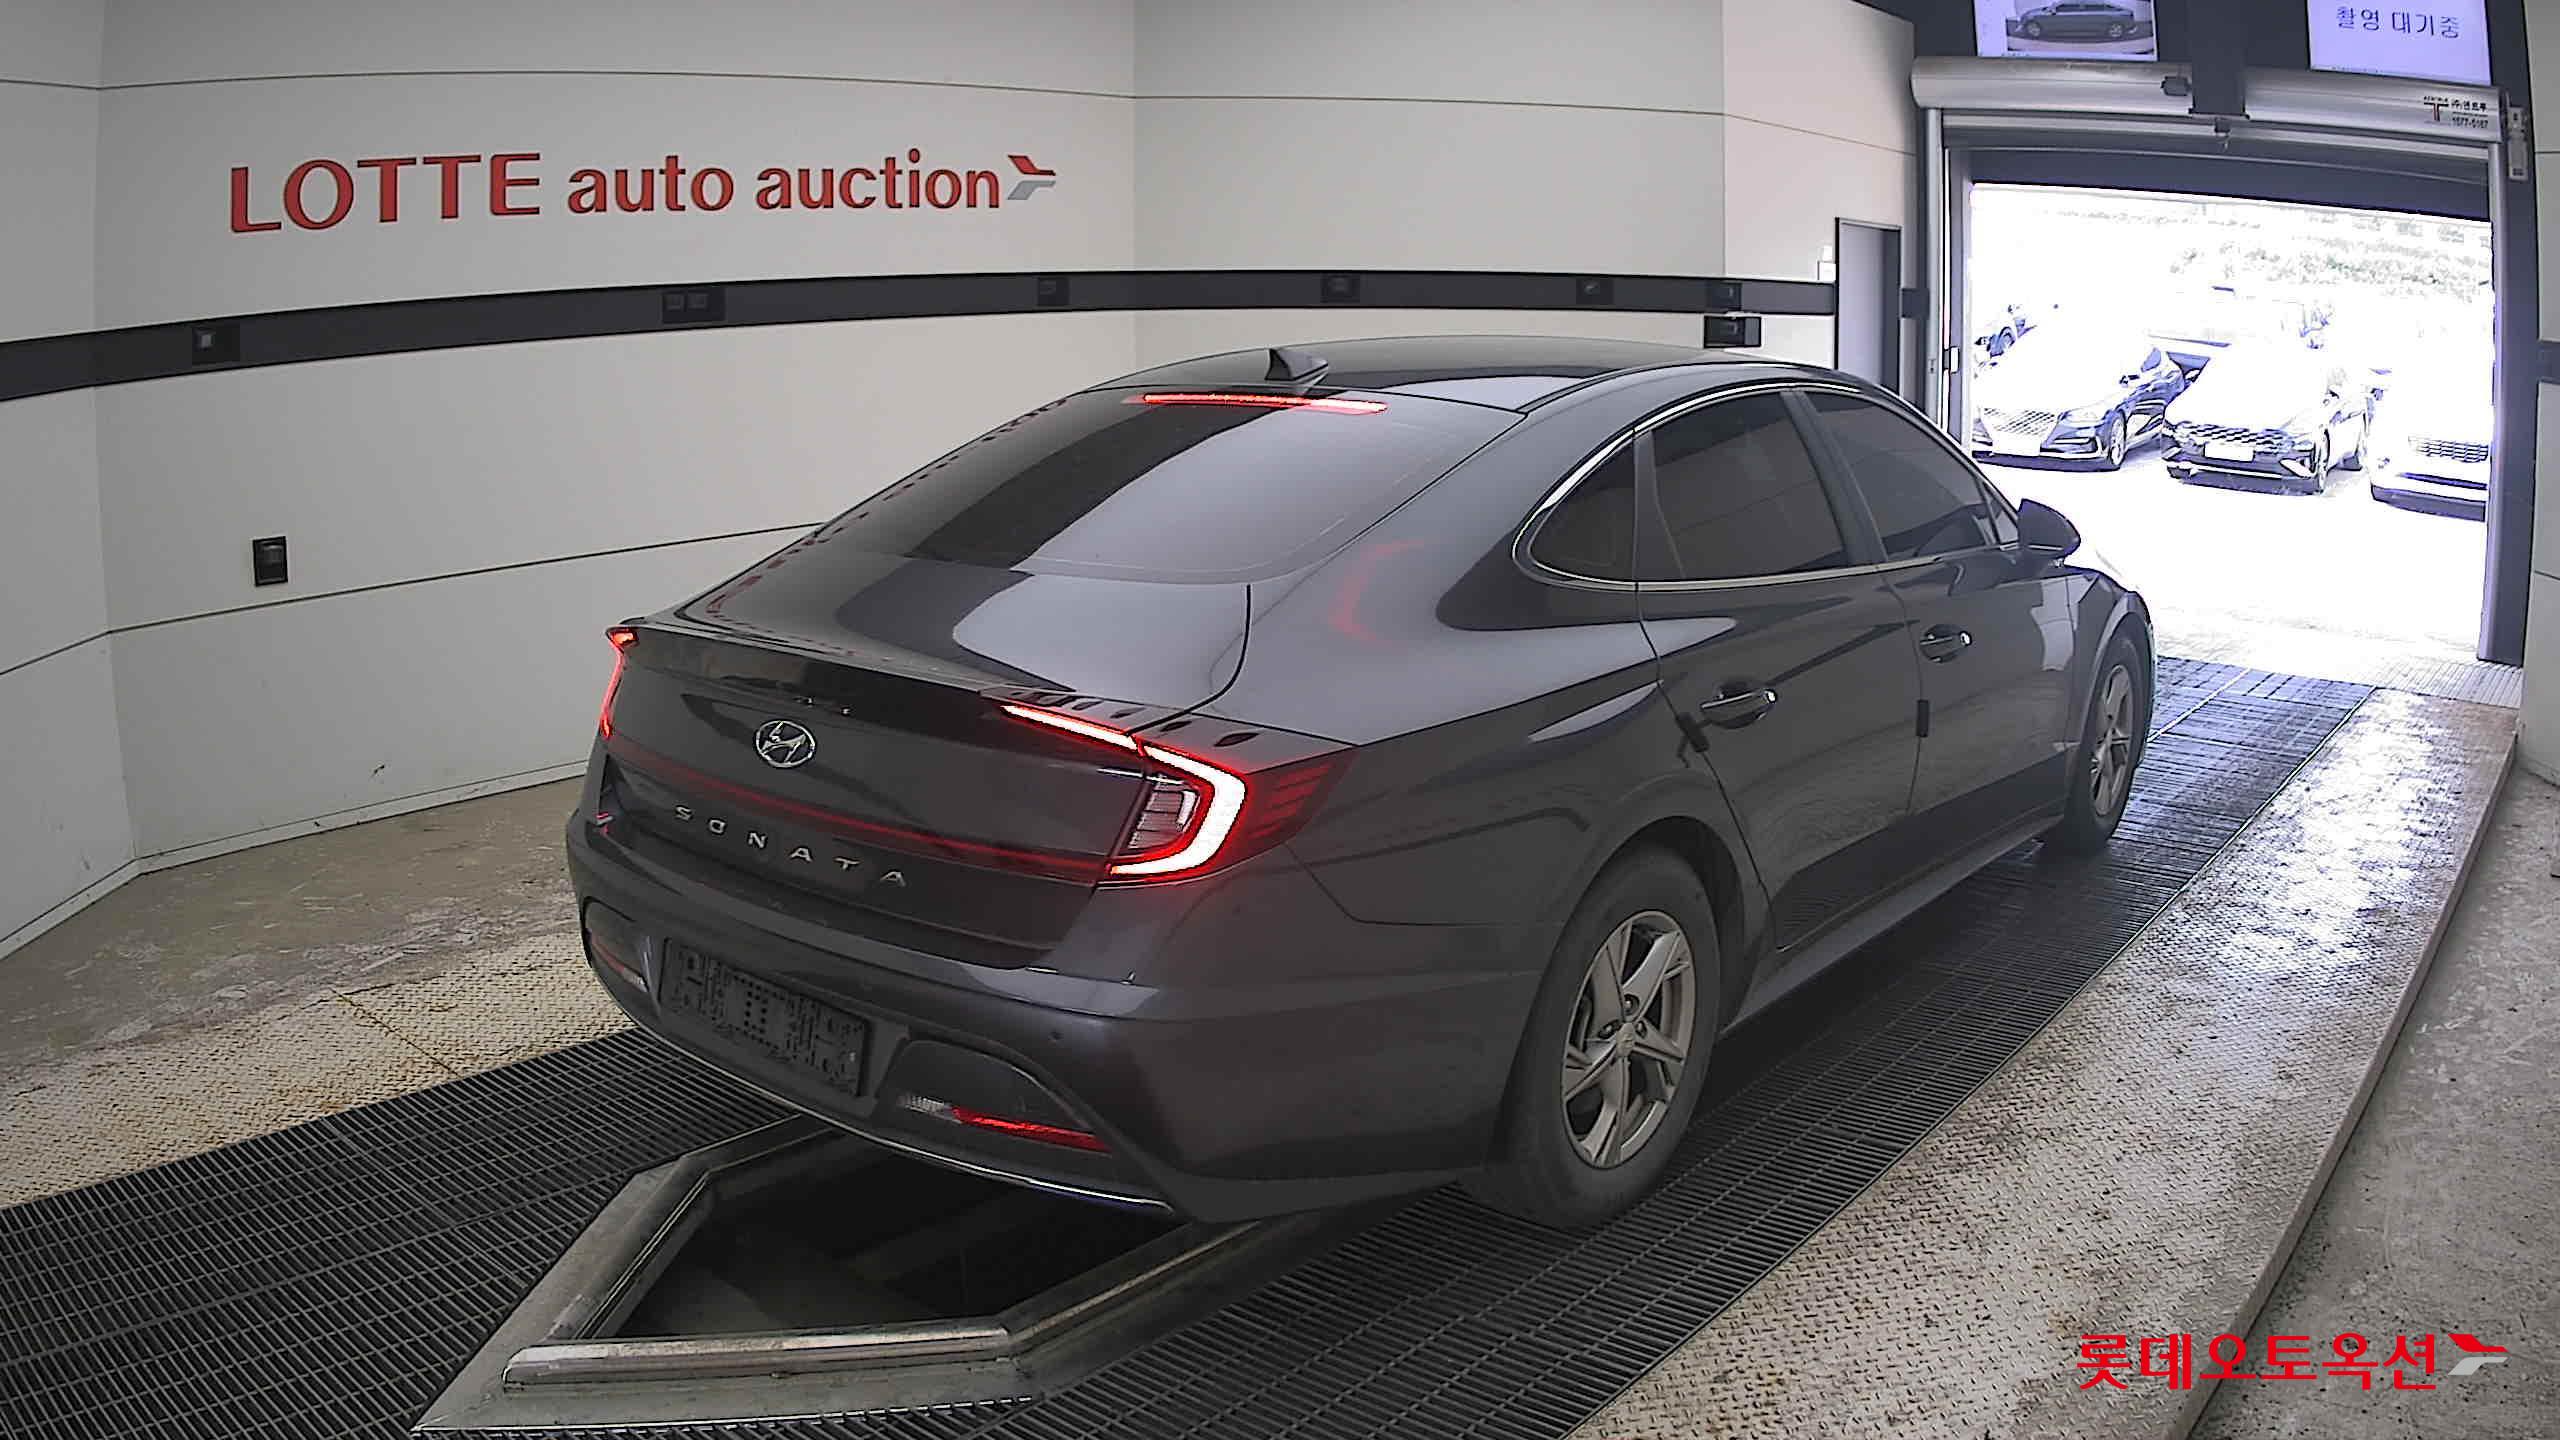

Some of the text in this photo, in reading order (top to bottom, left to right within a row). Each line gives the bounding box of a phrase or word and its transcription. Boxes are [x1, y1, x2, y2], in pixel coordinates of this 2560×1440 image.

[2337, 6, 2459, 39] 촬영 대기중
[230, 147, 1001, 233] LOTTE auto auction
[674, 805, 907, 887] SONATA
